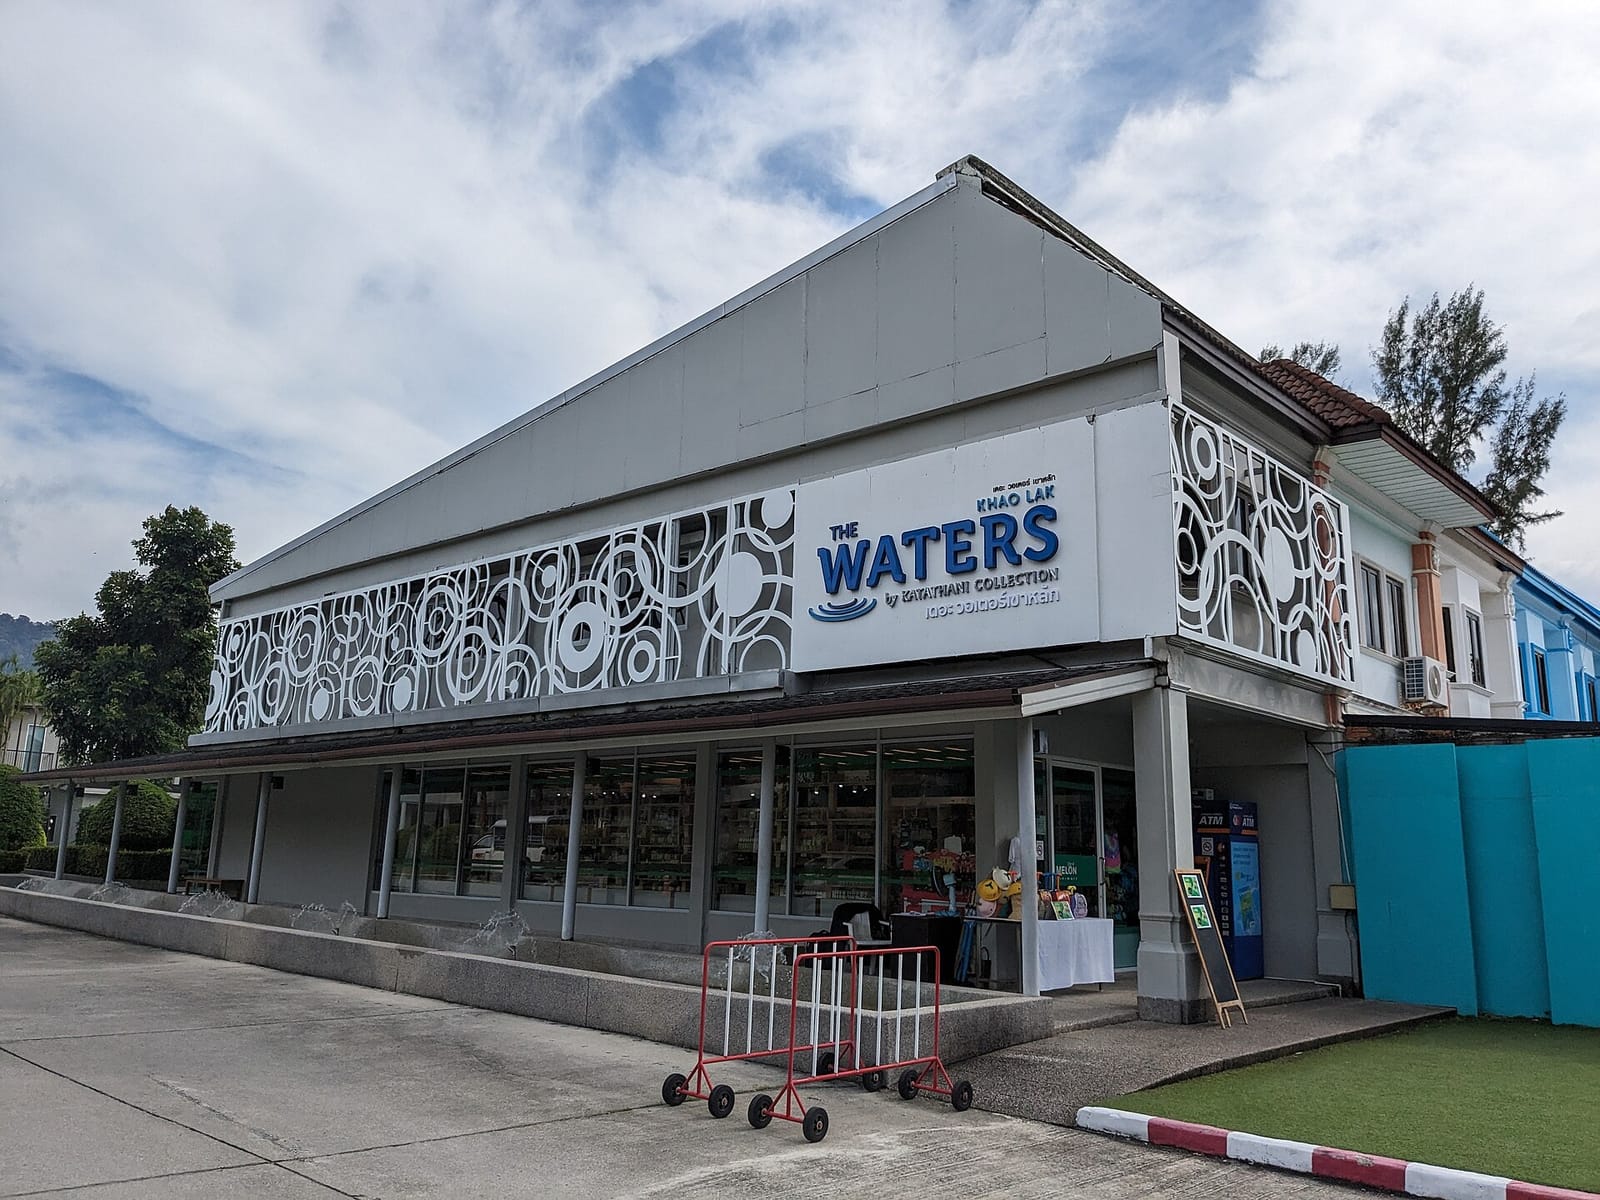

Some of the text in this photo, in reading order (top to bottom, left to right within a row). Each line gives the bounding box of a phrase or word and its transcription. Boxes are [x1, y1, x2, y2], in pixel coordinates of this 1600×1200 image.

[976, 484, 1056, 512] KHAO LAK
[829, 521, 859, 541] THE
[817, 504, 1060, 595] WATERS
[884, 567, 1060, 608] by KATATHANI COLLECTION
[1198, 815, 1224, 825] ATM
[1242, 817, 1255, 827] ATM
